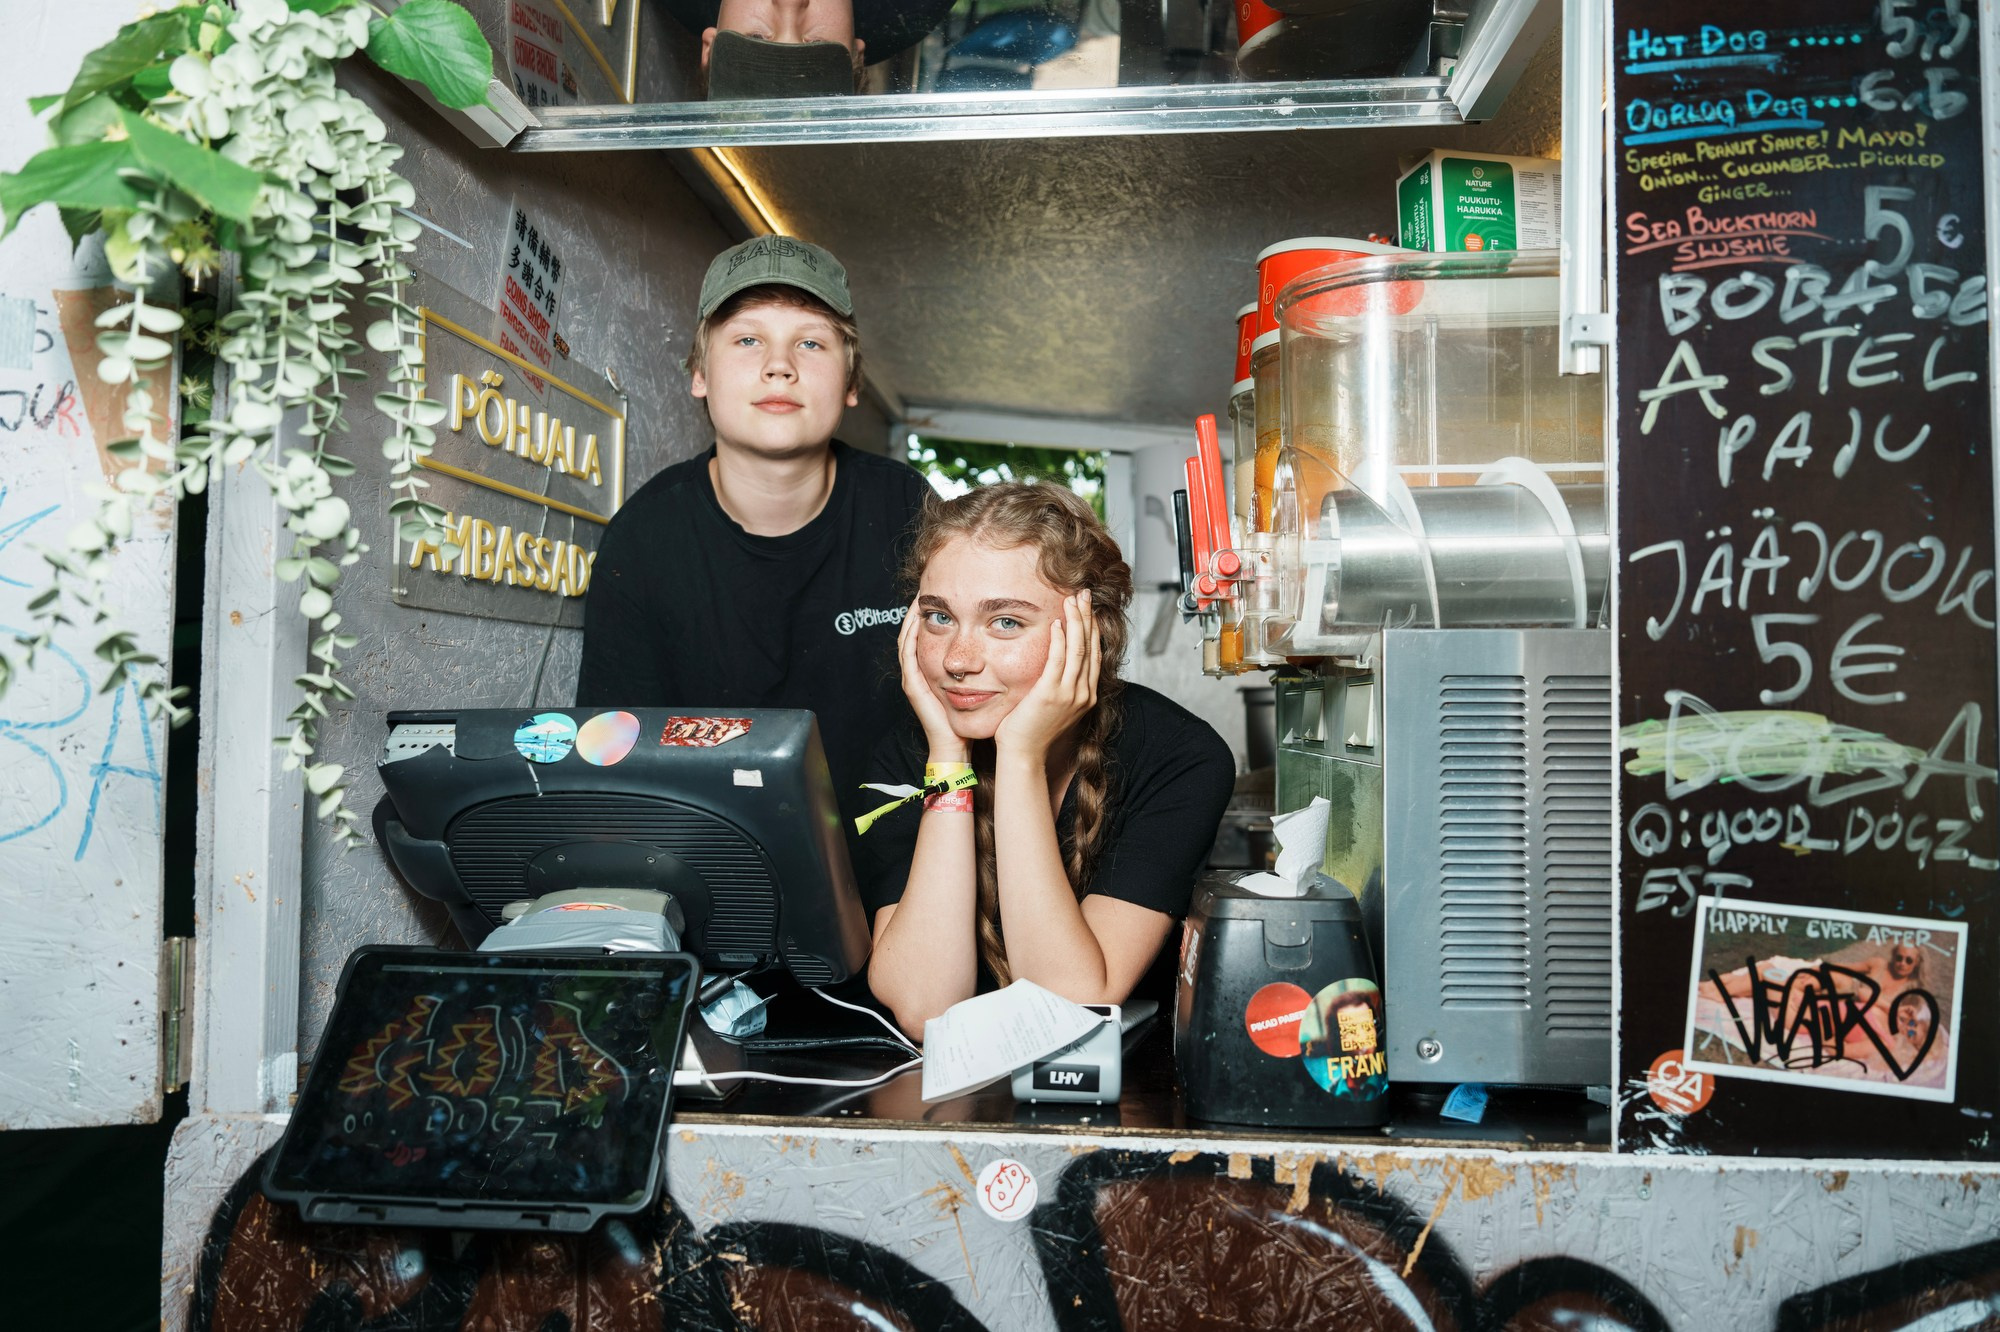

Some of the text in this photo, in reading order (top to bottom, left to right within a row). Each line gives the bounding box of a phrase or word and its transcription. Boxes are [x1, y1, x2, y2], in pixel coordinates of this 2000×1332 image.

[1628, 25, 1767, 60] HOT DOG
[1465, 179, 1492, 188] NATURE
[1456, 205, 1503, 216] HAARUKKA
[1626, 206, 1817, 244] SEA BUCKTHORN
[727, 239, 819, 276] EAST
[505, 275, 551, 341] COINS SHORT
[529, 334, 553, 369] EXACT
[1806, 920, 1858, 940] EVER
[1049, 1071, 1084, 1086] LHV
